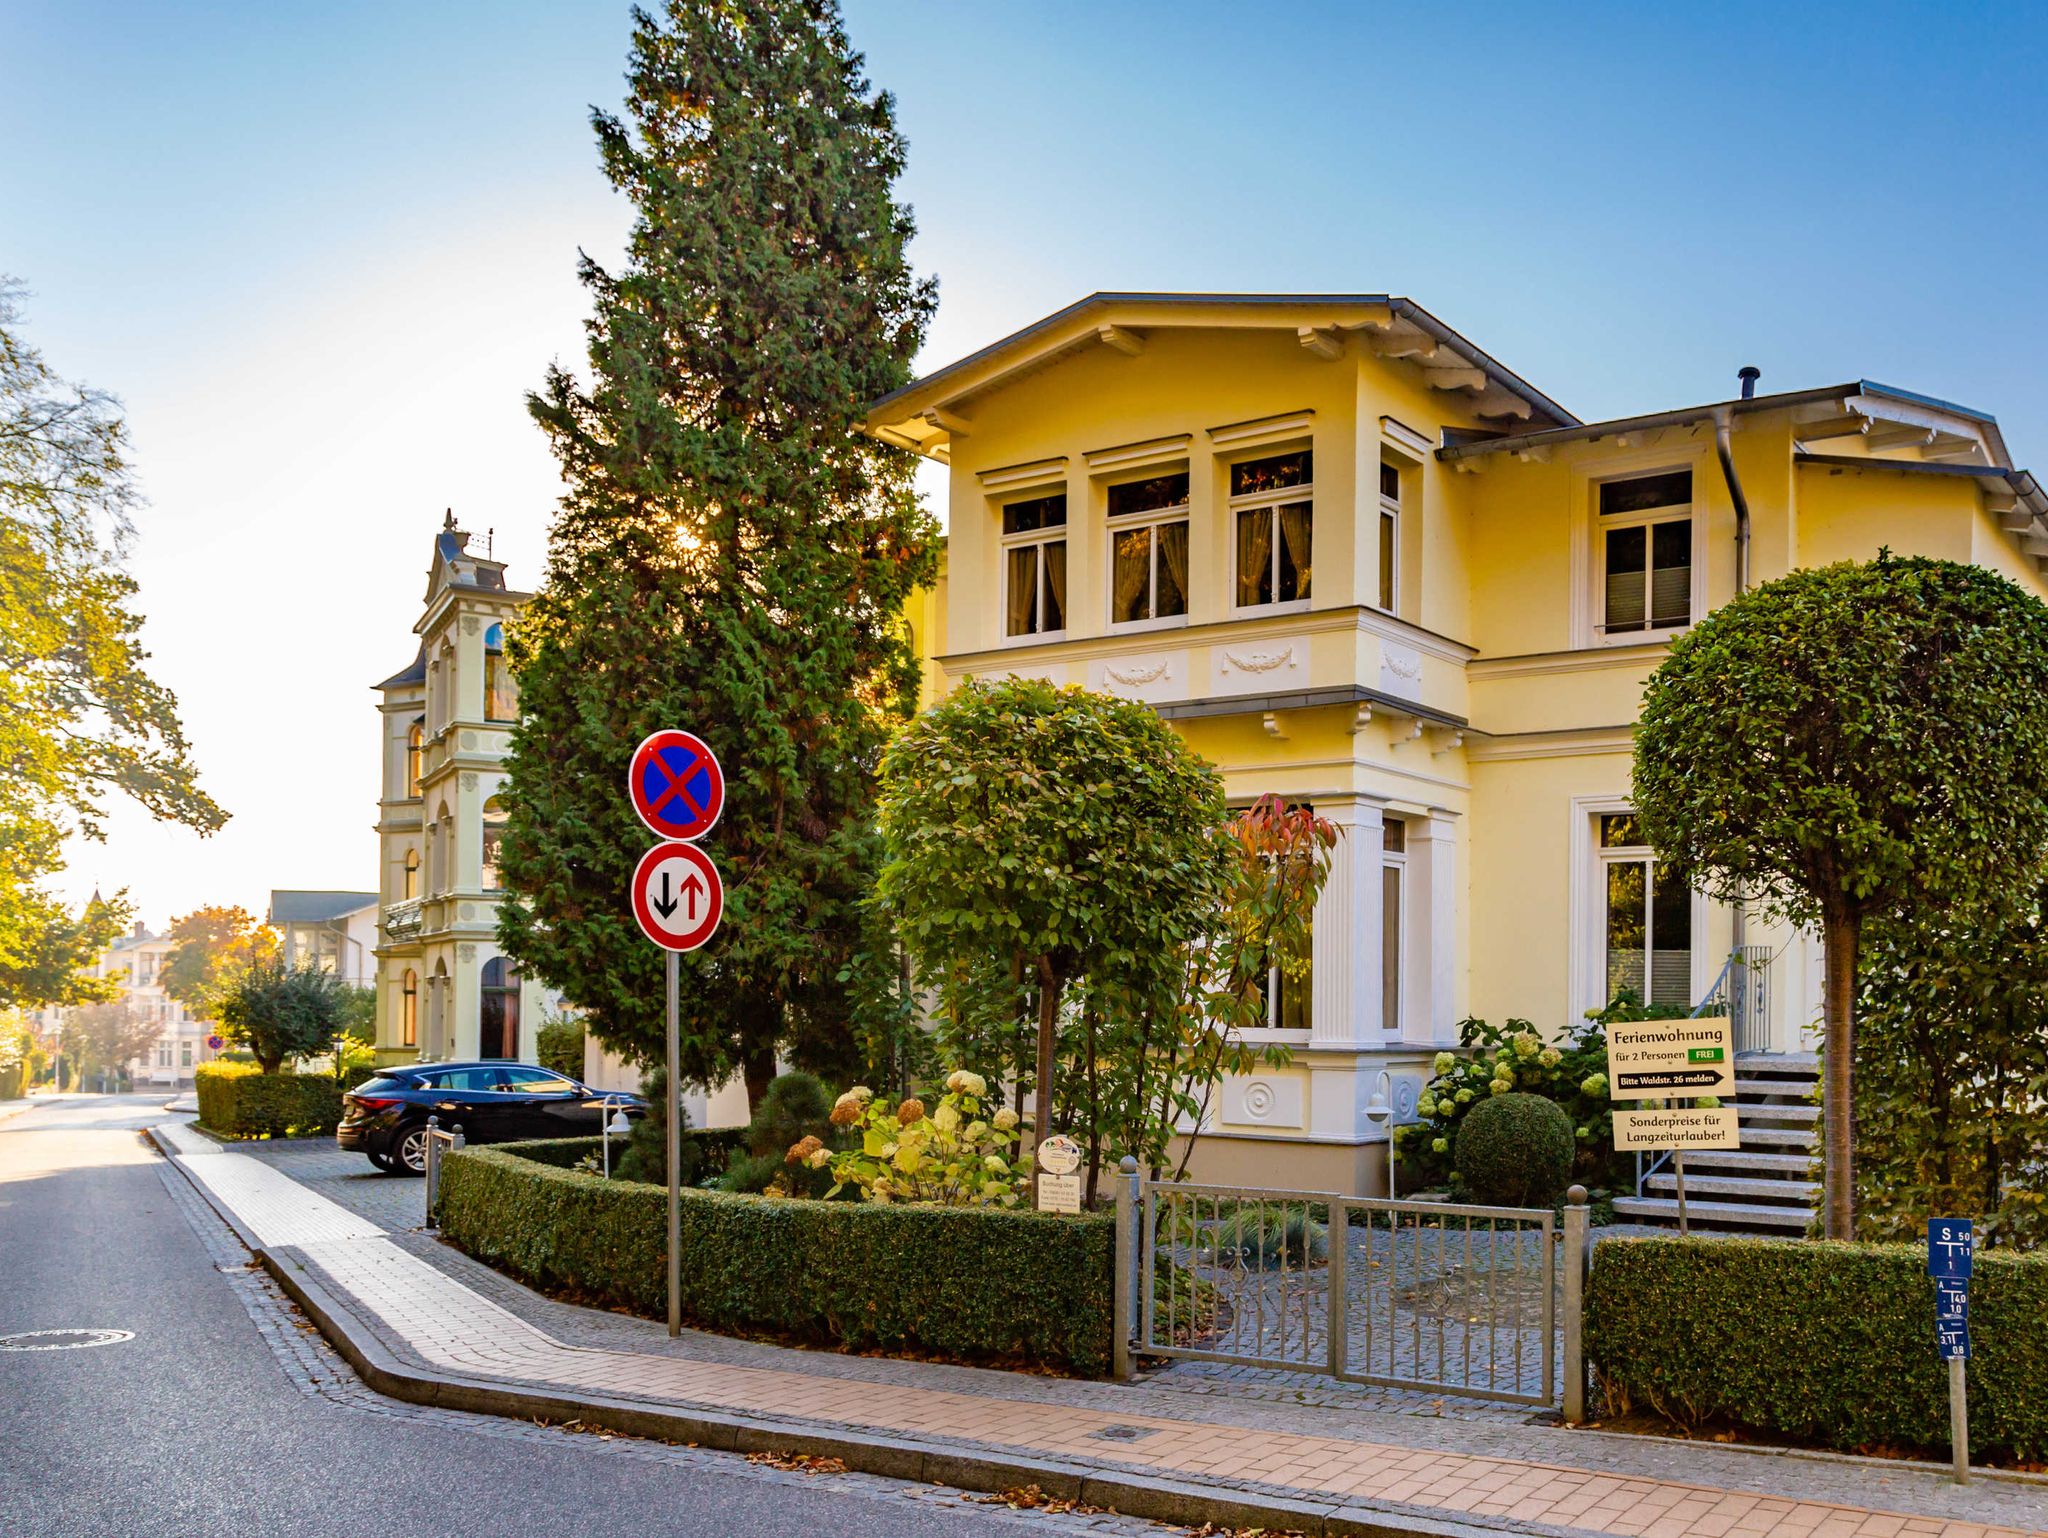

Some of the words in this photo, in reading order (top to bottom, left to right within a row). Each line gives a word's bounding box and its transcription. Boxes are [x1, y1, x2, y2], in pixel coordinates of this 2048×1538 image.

[1614, 1028, 1723, 1044] Ferienwohnung
[1615, 1052, 1629, 1062] für
[1632, 1052, 1639, 1061] 2
[1641, 1051, 1685, 1061] Personen
[1695, 1050, 1715, 1059] FREI
[1620, 1077, 1639, 1086] Bitte
[1639, 1076, 1672, 1085] Waldstr.
[1673, 1075, 1684, 1084] 26
[1685, 1074, 1715, 1083] melden
[1629, 1116, 1703, 1129] Sonderpreise
[1704, 1115, 1721, 1126] für
[1626, 1130, 1726, 1144] Langzeiturlauber!
[1941, 1227, 1951, 1241] S
[1958, 1232, 1970, 1241] 50
[1948, 1261, 1953, 1270] 1
[1939, 1281, 1945, 1289] A
[1939, 1323, 1945, 1332] A
